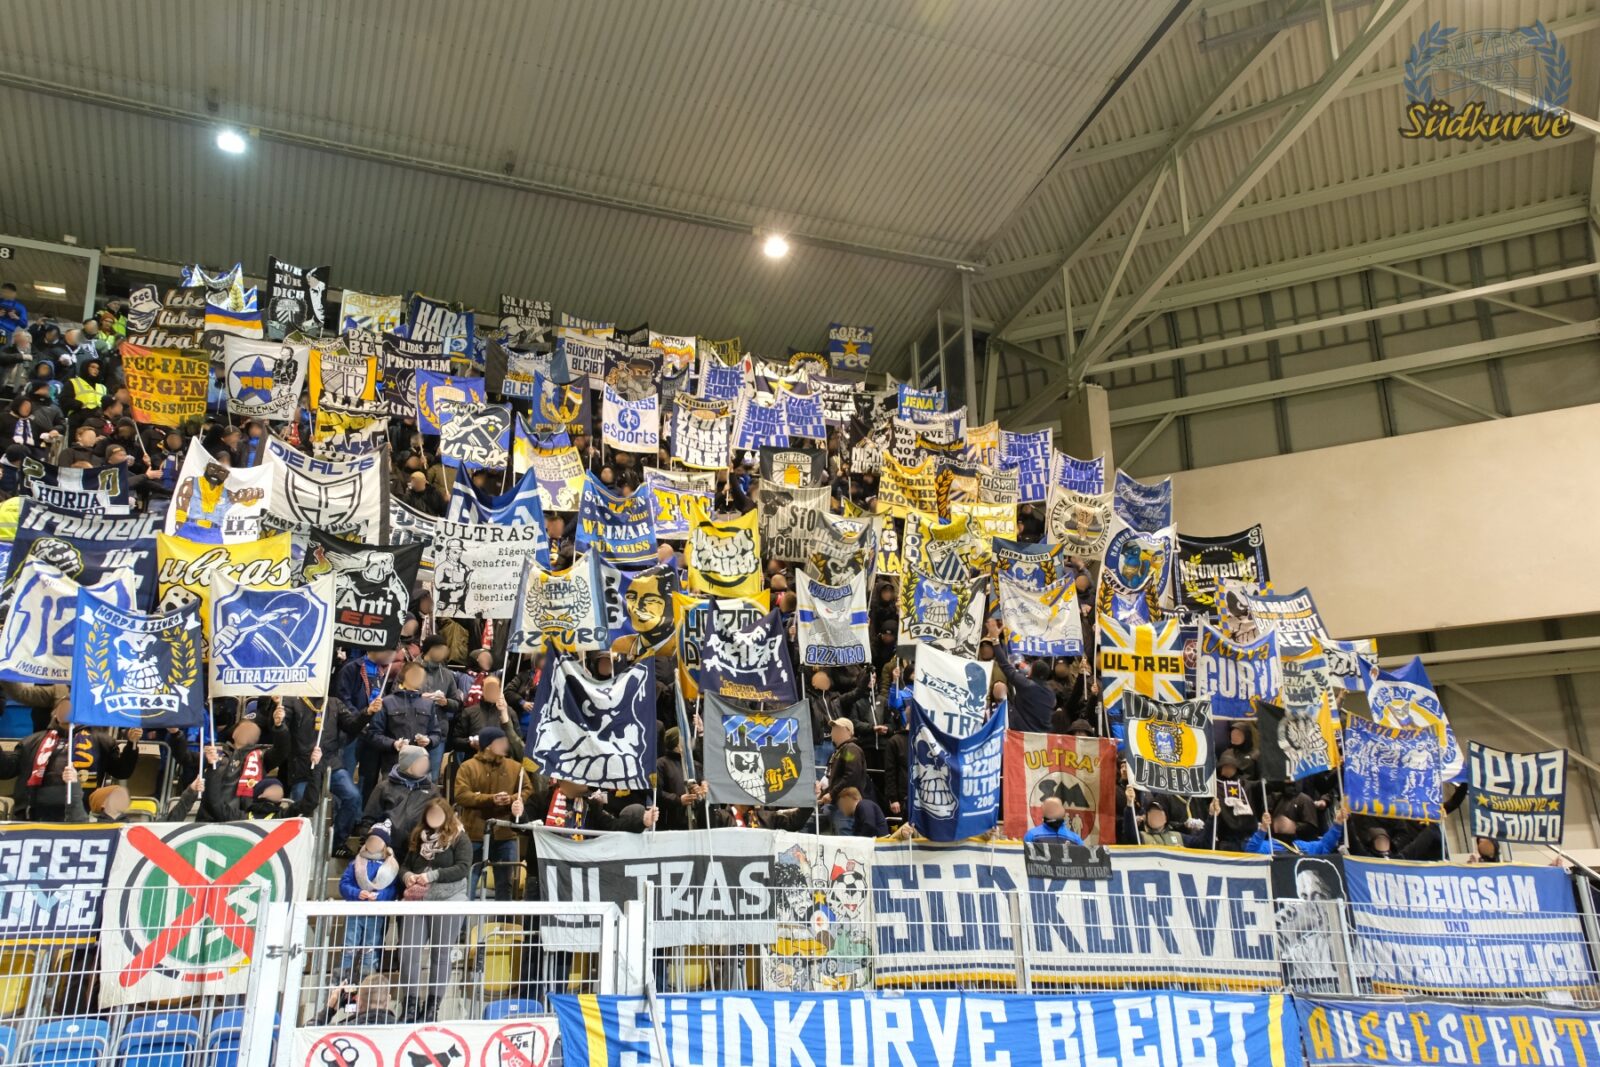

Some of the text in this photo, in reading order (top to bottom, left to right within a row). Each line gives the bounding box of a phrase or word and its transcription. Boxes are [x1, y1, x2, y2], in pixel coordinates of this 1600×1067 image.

[274, 260, 303, 277] NUR
[274, 273, 303, 288] FÜR
[272, 287, 305, 300] DICH
[502, 294, 552, 311] ULTRAS
[503, 305, 551, 320] CARL ZEISS
[124, 356, 208, 377] FCC-FANS
[386, 353, 451, 373] PROBLEM
[831, 352, 871, 370] FCC
[126, 374, 208, 397] GEGEN
[901, 395, 934, 411] JENA
[603, 422, 658, 446] eSports
[269, 440, 306, 469] DIE
[440, 439, 508, 468] ULTRAS
[880, 470, 935, 487] FOOTBALL
[880, 480, 936, 500] NOT THE
[994, 493, 1014, 504] den
[879, 491, 938, 512] MONEY
[443, 520, 536, 543] ULTRAS
[582, 517, 650, 541] WEIMAR
[158, 547, 291, 586] ultras
[1178, 555, 1257, 585] NAUMBURG
[543, 582, 568, 592] JENA
[544, 591, 566, 600] CITY
[336, 590, 393, 617] Anti
[33, 595, 78, 658] 12
[139, 613, 182, 633] AZZURO
[15, 660, 69, 678] IMMER MIT
[1103, 653, 1180, 674] ULTRAS
[225, 668, 307, 683] ULTRA AZZURO
[1200, 655, 1281, 700] CURVA
[107, 693, 178, 713] ULTRAS
[1475, 808, 1561, 845] branco
[545, 860, 772, 928] ULTRAS
[1366, 871, 1540, 913] UNBEUGSAM
[1444, 920, 1470, 933] UND
[1354, 938, 1591, 985] UNVERKÄUFLICH
[617, 996, 1256, 1067] SÜDKURVE BLEIBT
[1308, 1006, 1600, 1067] AUSGESPERRT
